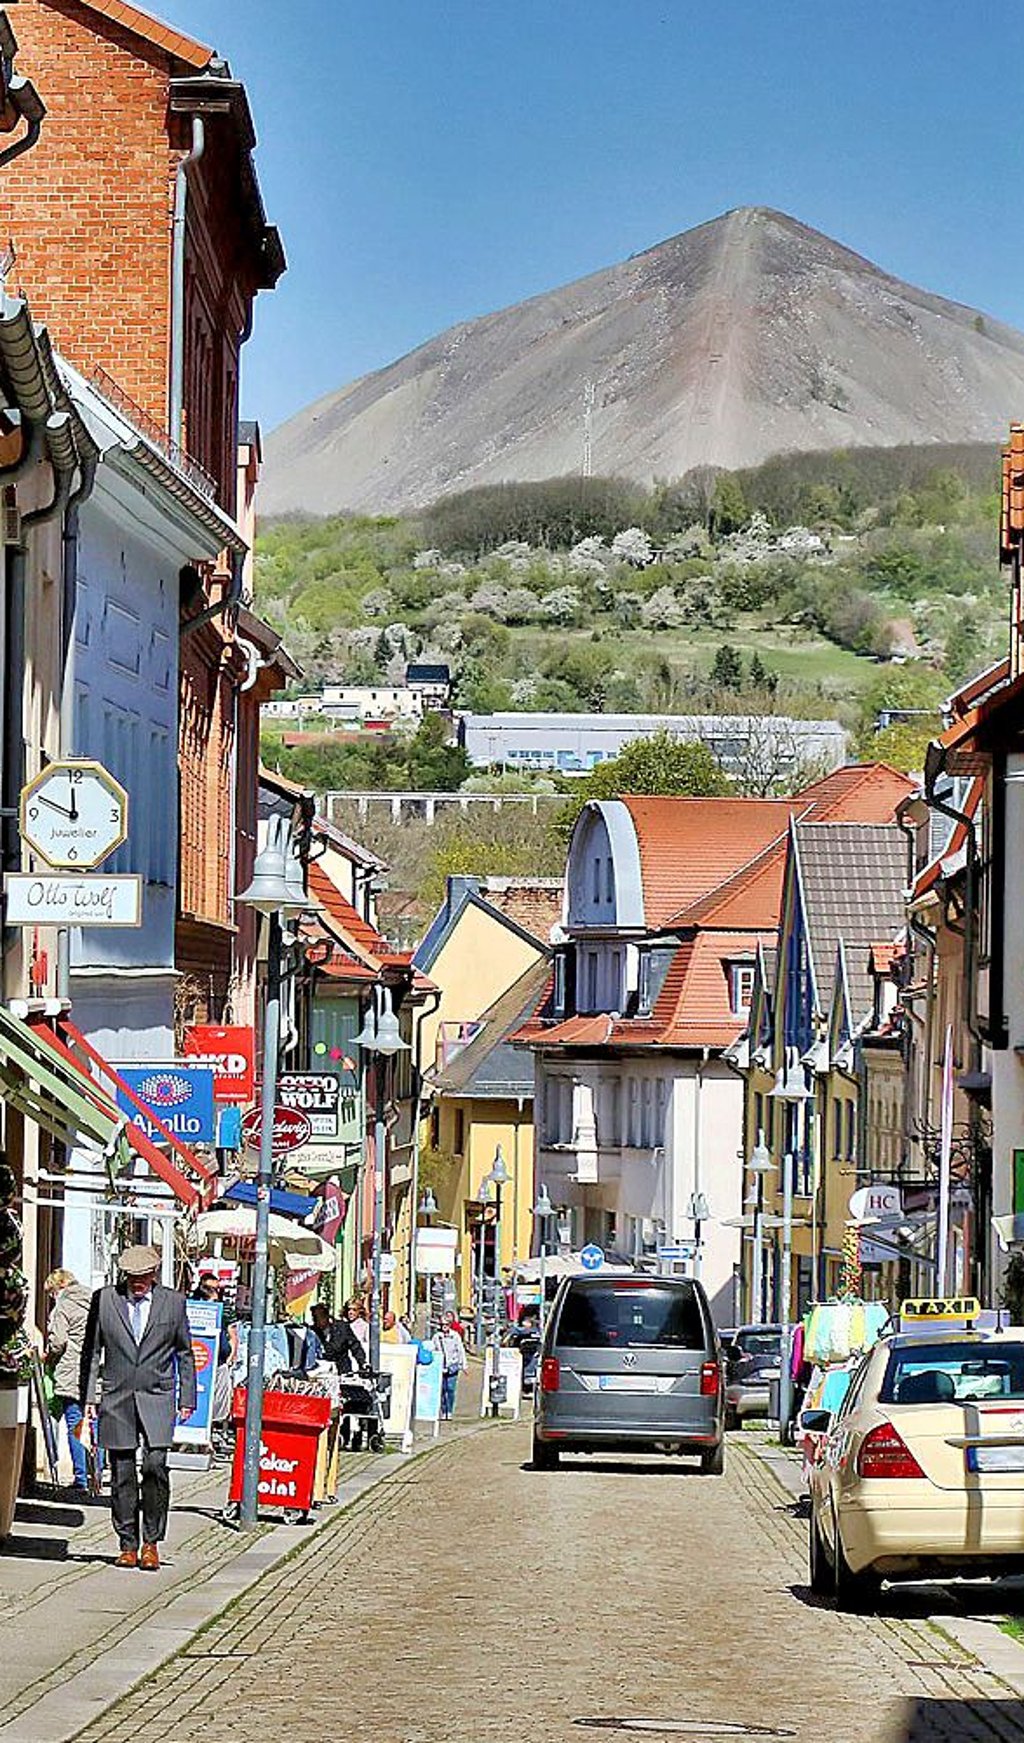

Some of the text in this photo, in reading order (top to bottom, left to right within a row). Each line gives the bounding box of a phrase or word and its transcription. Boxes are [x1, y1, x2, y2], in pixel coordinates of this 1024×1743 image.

[67, 769, 83, 784] 12
[29, 807, 39, 821] 9
[109, 809, 120, 823] 3
[67, 846, 78, 860] 6
[27, 882, 68, 907] Otto
[280, 1075, 339, 1093] OTTO
[280, 1093, 339, 1108] WOLF
[242, 1114, 307, 1140] Ldwig
[870, 1195, 894, 1209] HC
[914, 1300, 969, 1314] TAXI
[257, 1479, 297, 1497] oint
